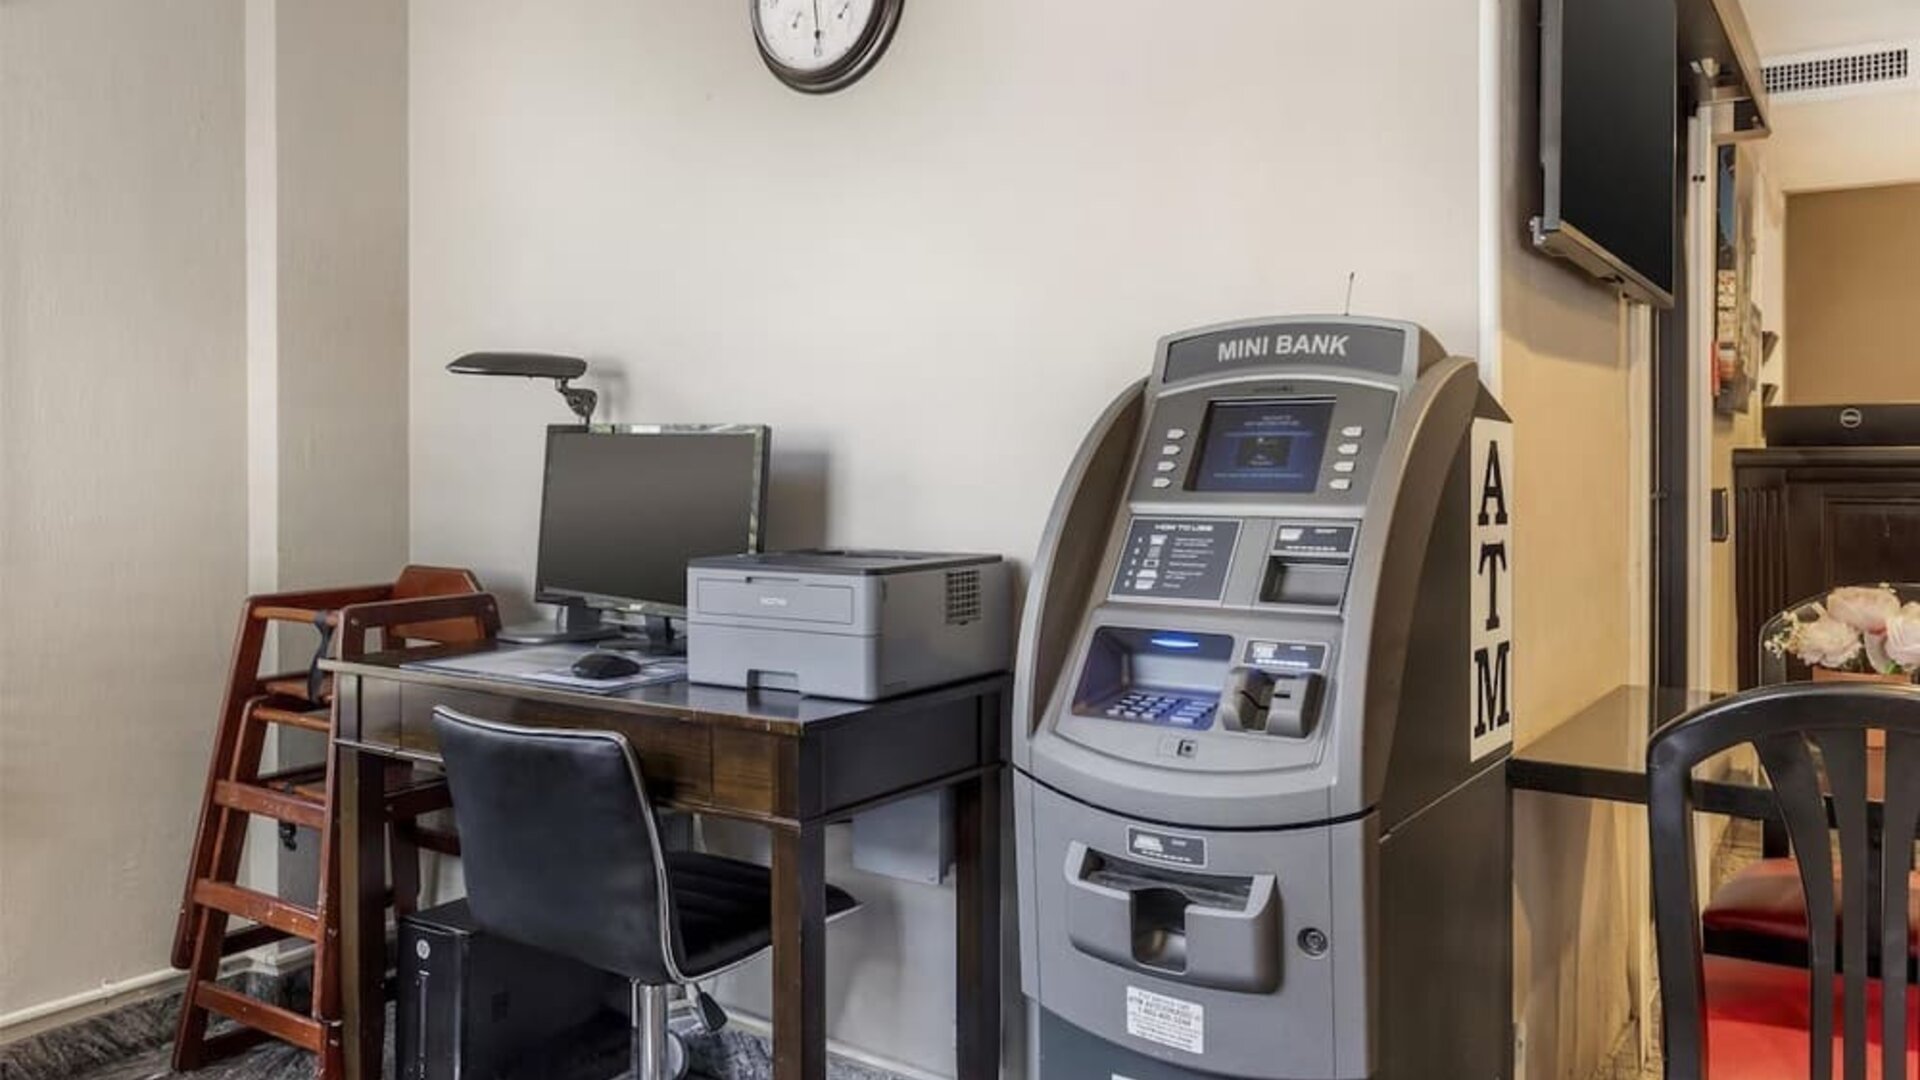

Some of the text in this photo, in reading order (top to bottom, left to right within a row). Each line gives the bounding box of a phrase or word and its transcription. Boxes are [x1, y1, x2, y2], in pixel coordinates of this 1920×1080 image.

[1218, 333, 1349, 363] MINI BANK
[1474, 440, 1510, 739] ATM
